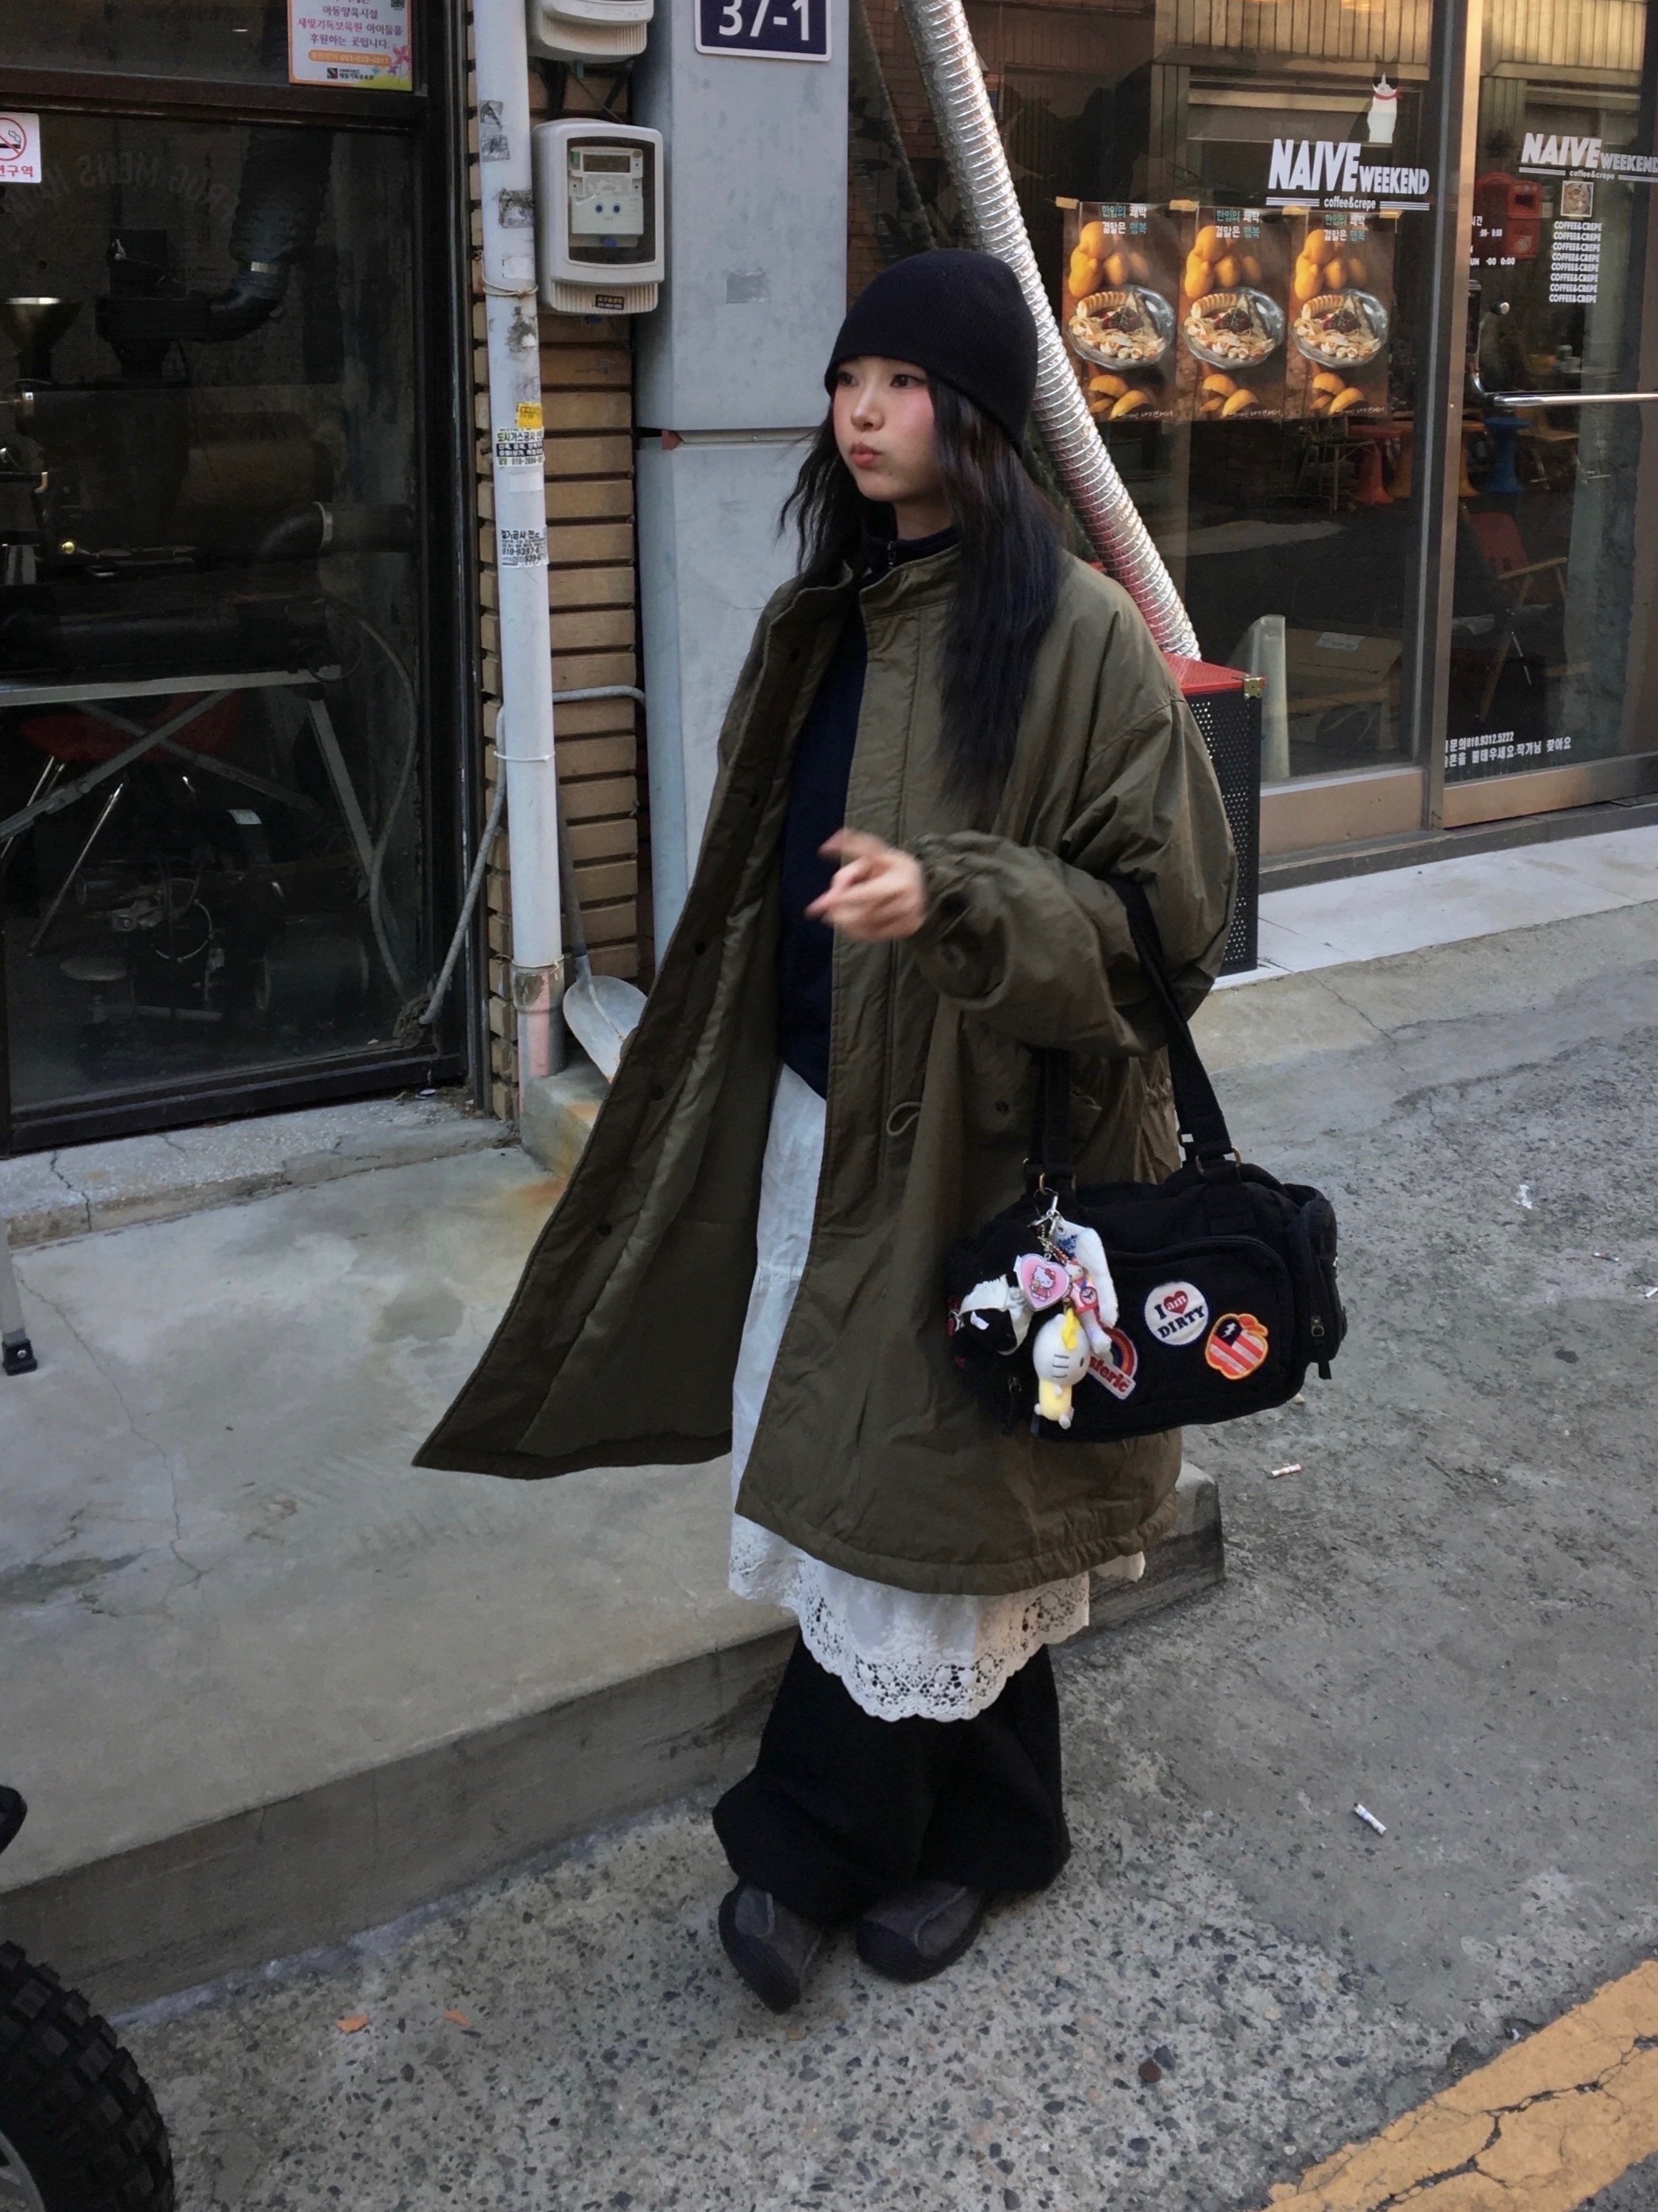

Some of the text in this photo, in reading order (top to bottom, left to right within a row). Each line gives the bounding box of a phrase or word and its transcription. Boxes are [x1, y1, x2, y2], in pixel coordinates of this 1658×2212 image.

[322, 5, 378, 20] 아동양육시설
[366, 24, 403, 35] 아이들을
[310, 34, 390, 49] 후원하는 곳입니다.
[1521, 132, 1658, 173] NAIVE WEEKEND
[1268, 139, 1429, 195] NAIVE WEEKEND
[1569, 169, 1615, 180] coffee&crepe
[1324, 196, 1376, 212] coffee&crepe
[1102, 222, 1126, 234] 결말은
[1554, 220, 1602, 231] COFFEE&CREPE
[1215, 226, 1240, 238] 결말은
[1323, 230, 1347, 241] 결말은
[1553, 231, 1602, 242] COFFEE&CREPE
[1552, 242, 1601, 252] COFFEE&CREPE
[1551, 252, 1600, 262] COFFEE&CREPE
[1551, 262, 1599, 272] COFFEE&CREPE
[1550, 272, 1599, 282] COFFEE&CREPE
[1549, 283, 1598, 293] COFFEE&CREPE
[1549, 293, 1597, 303] COFFEE&CREPE
[1154, 1295, 1187, 1320] I am
[1158, 1305, 1205, 1338] DIRTY
